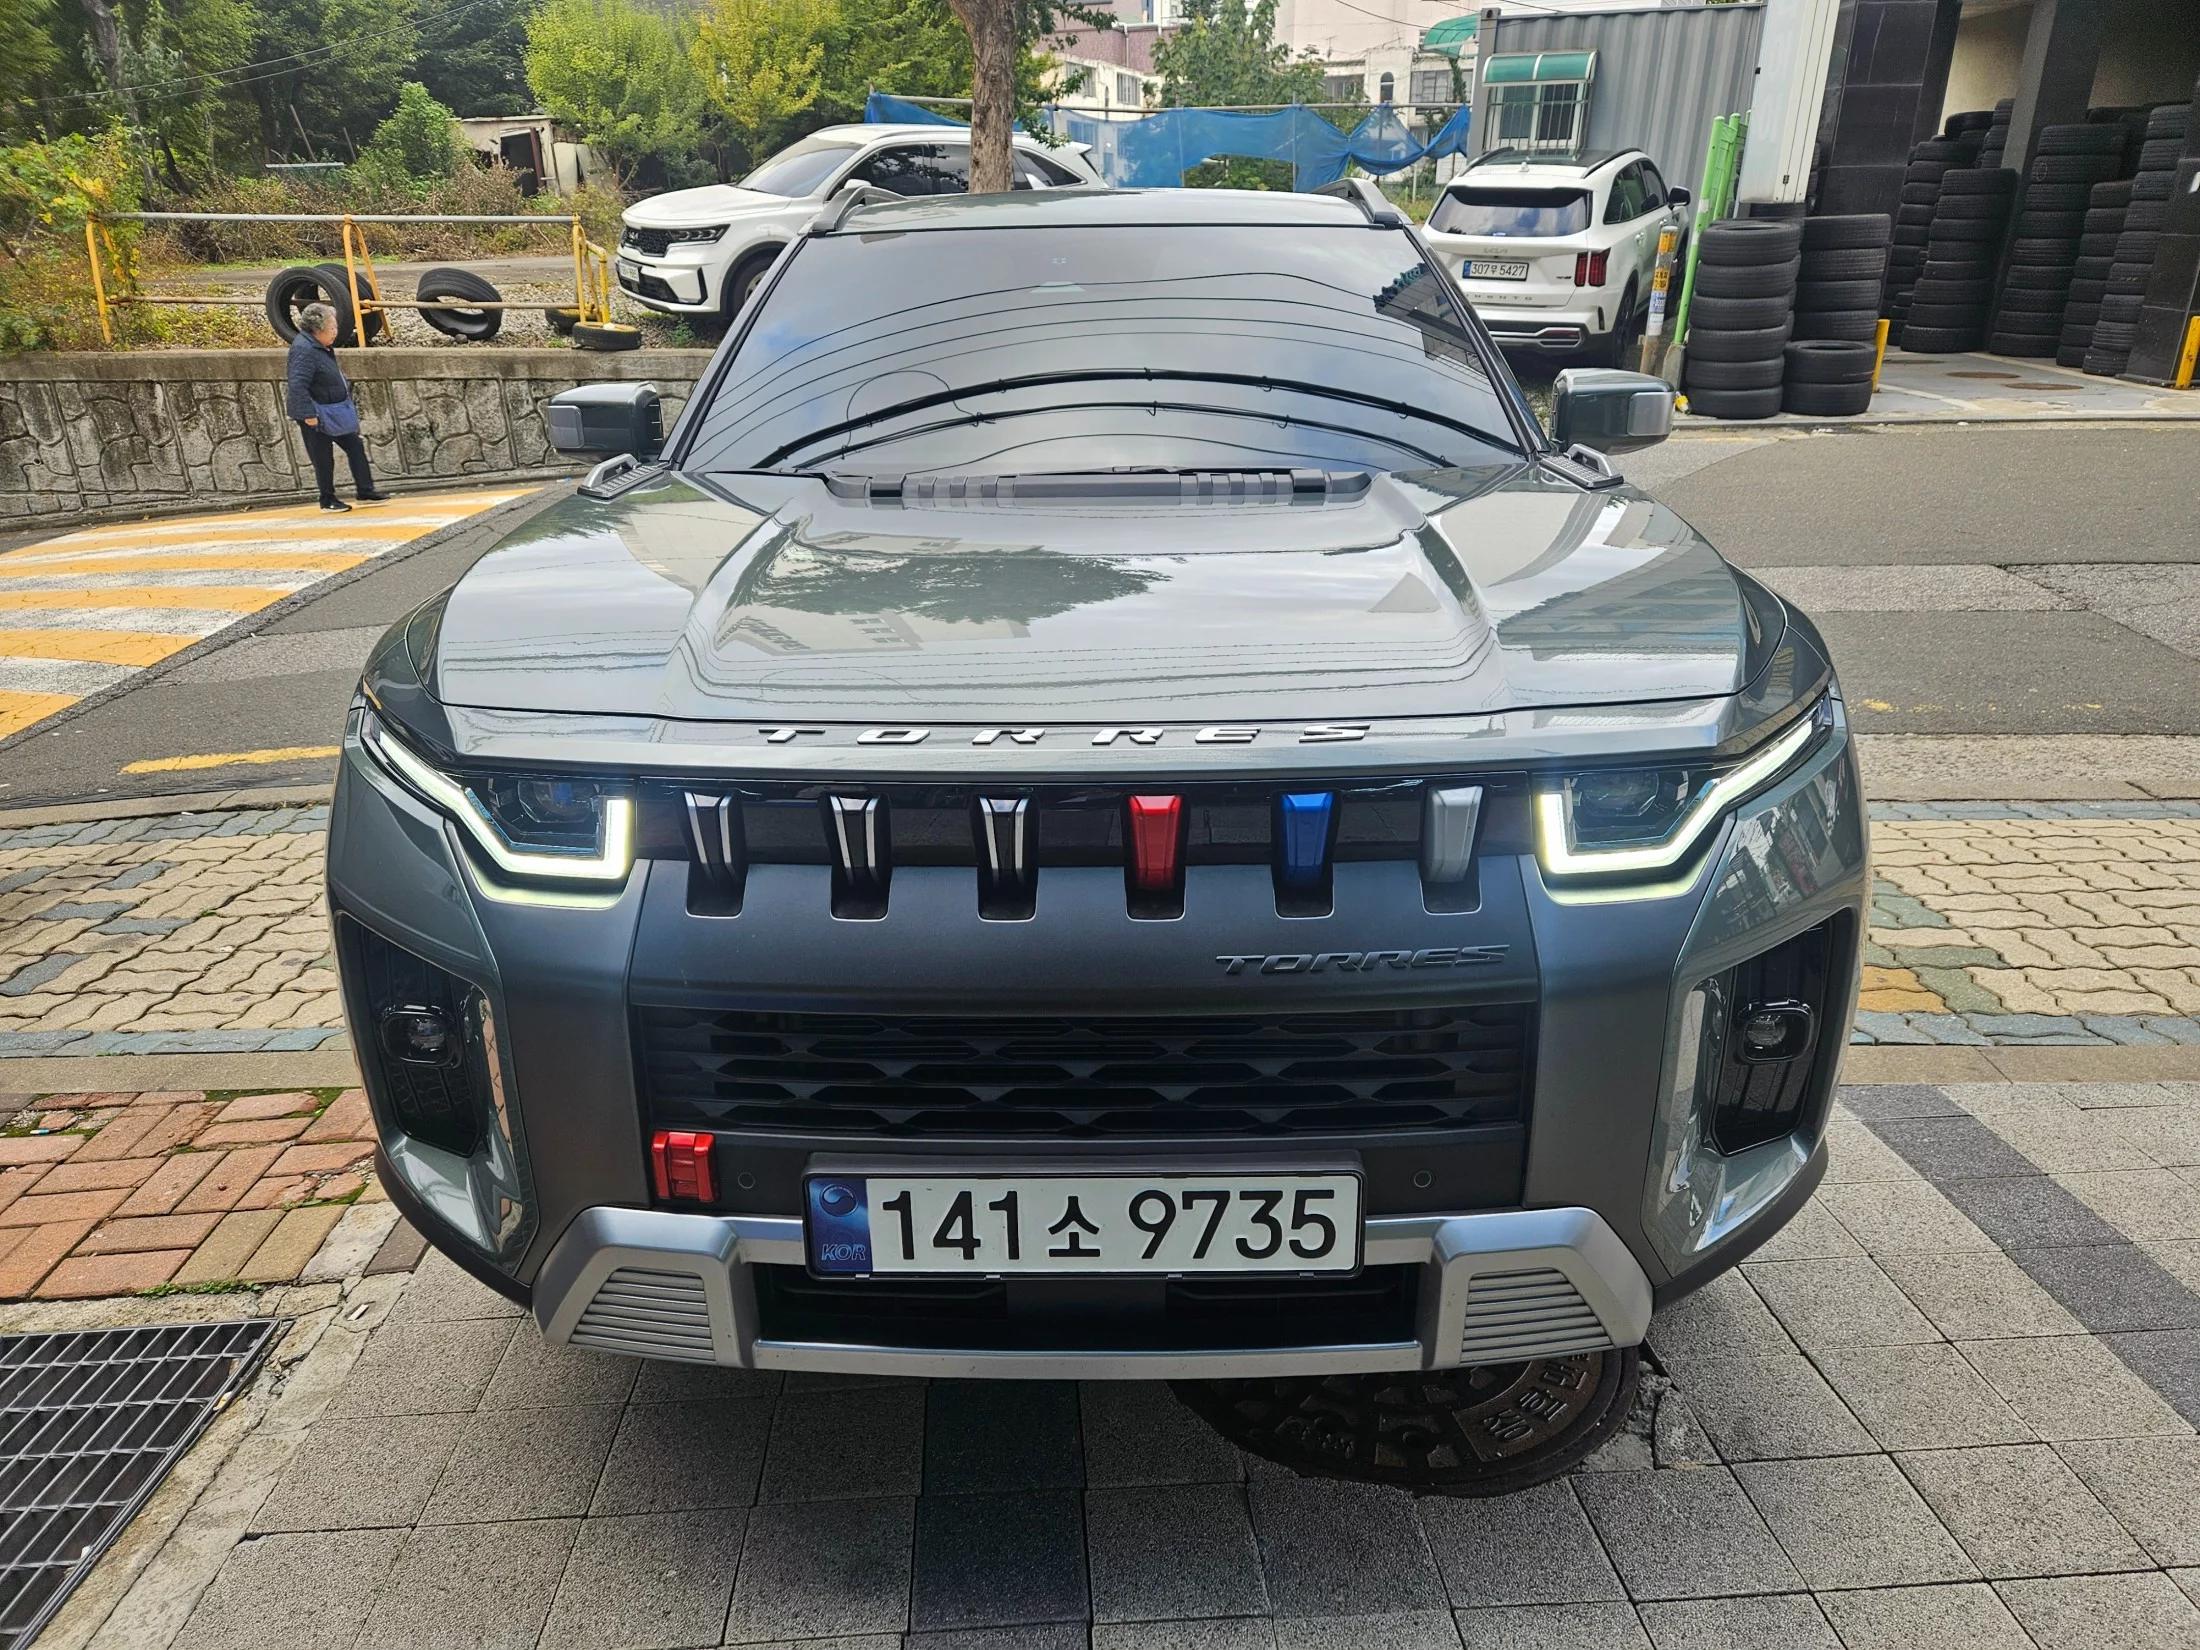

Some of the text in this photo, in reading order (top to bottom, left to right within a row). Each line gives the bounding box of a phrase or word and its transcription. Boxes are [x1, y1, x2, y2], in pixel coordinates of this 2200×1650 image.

[1499, 264, 1525, 277] 5427
[758, 722, 1371, 745] TORRES
[1215, 944, 1510, 974] TORRES
[882, 1189, 1337, 1261] 141소 9735
[820, 1242, 866, 1262] KOR
